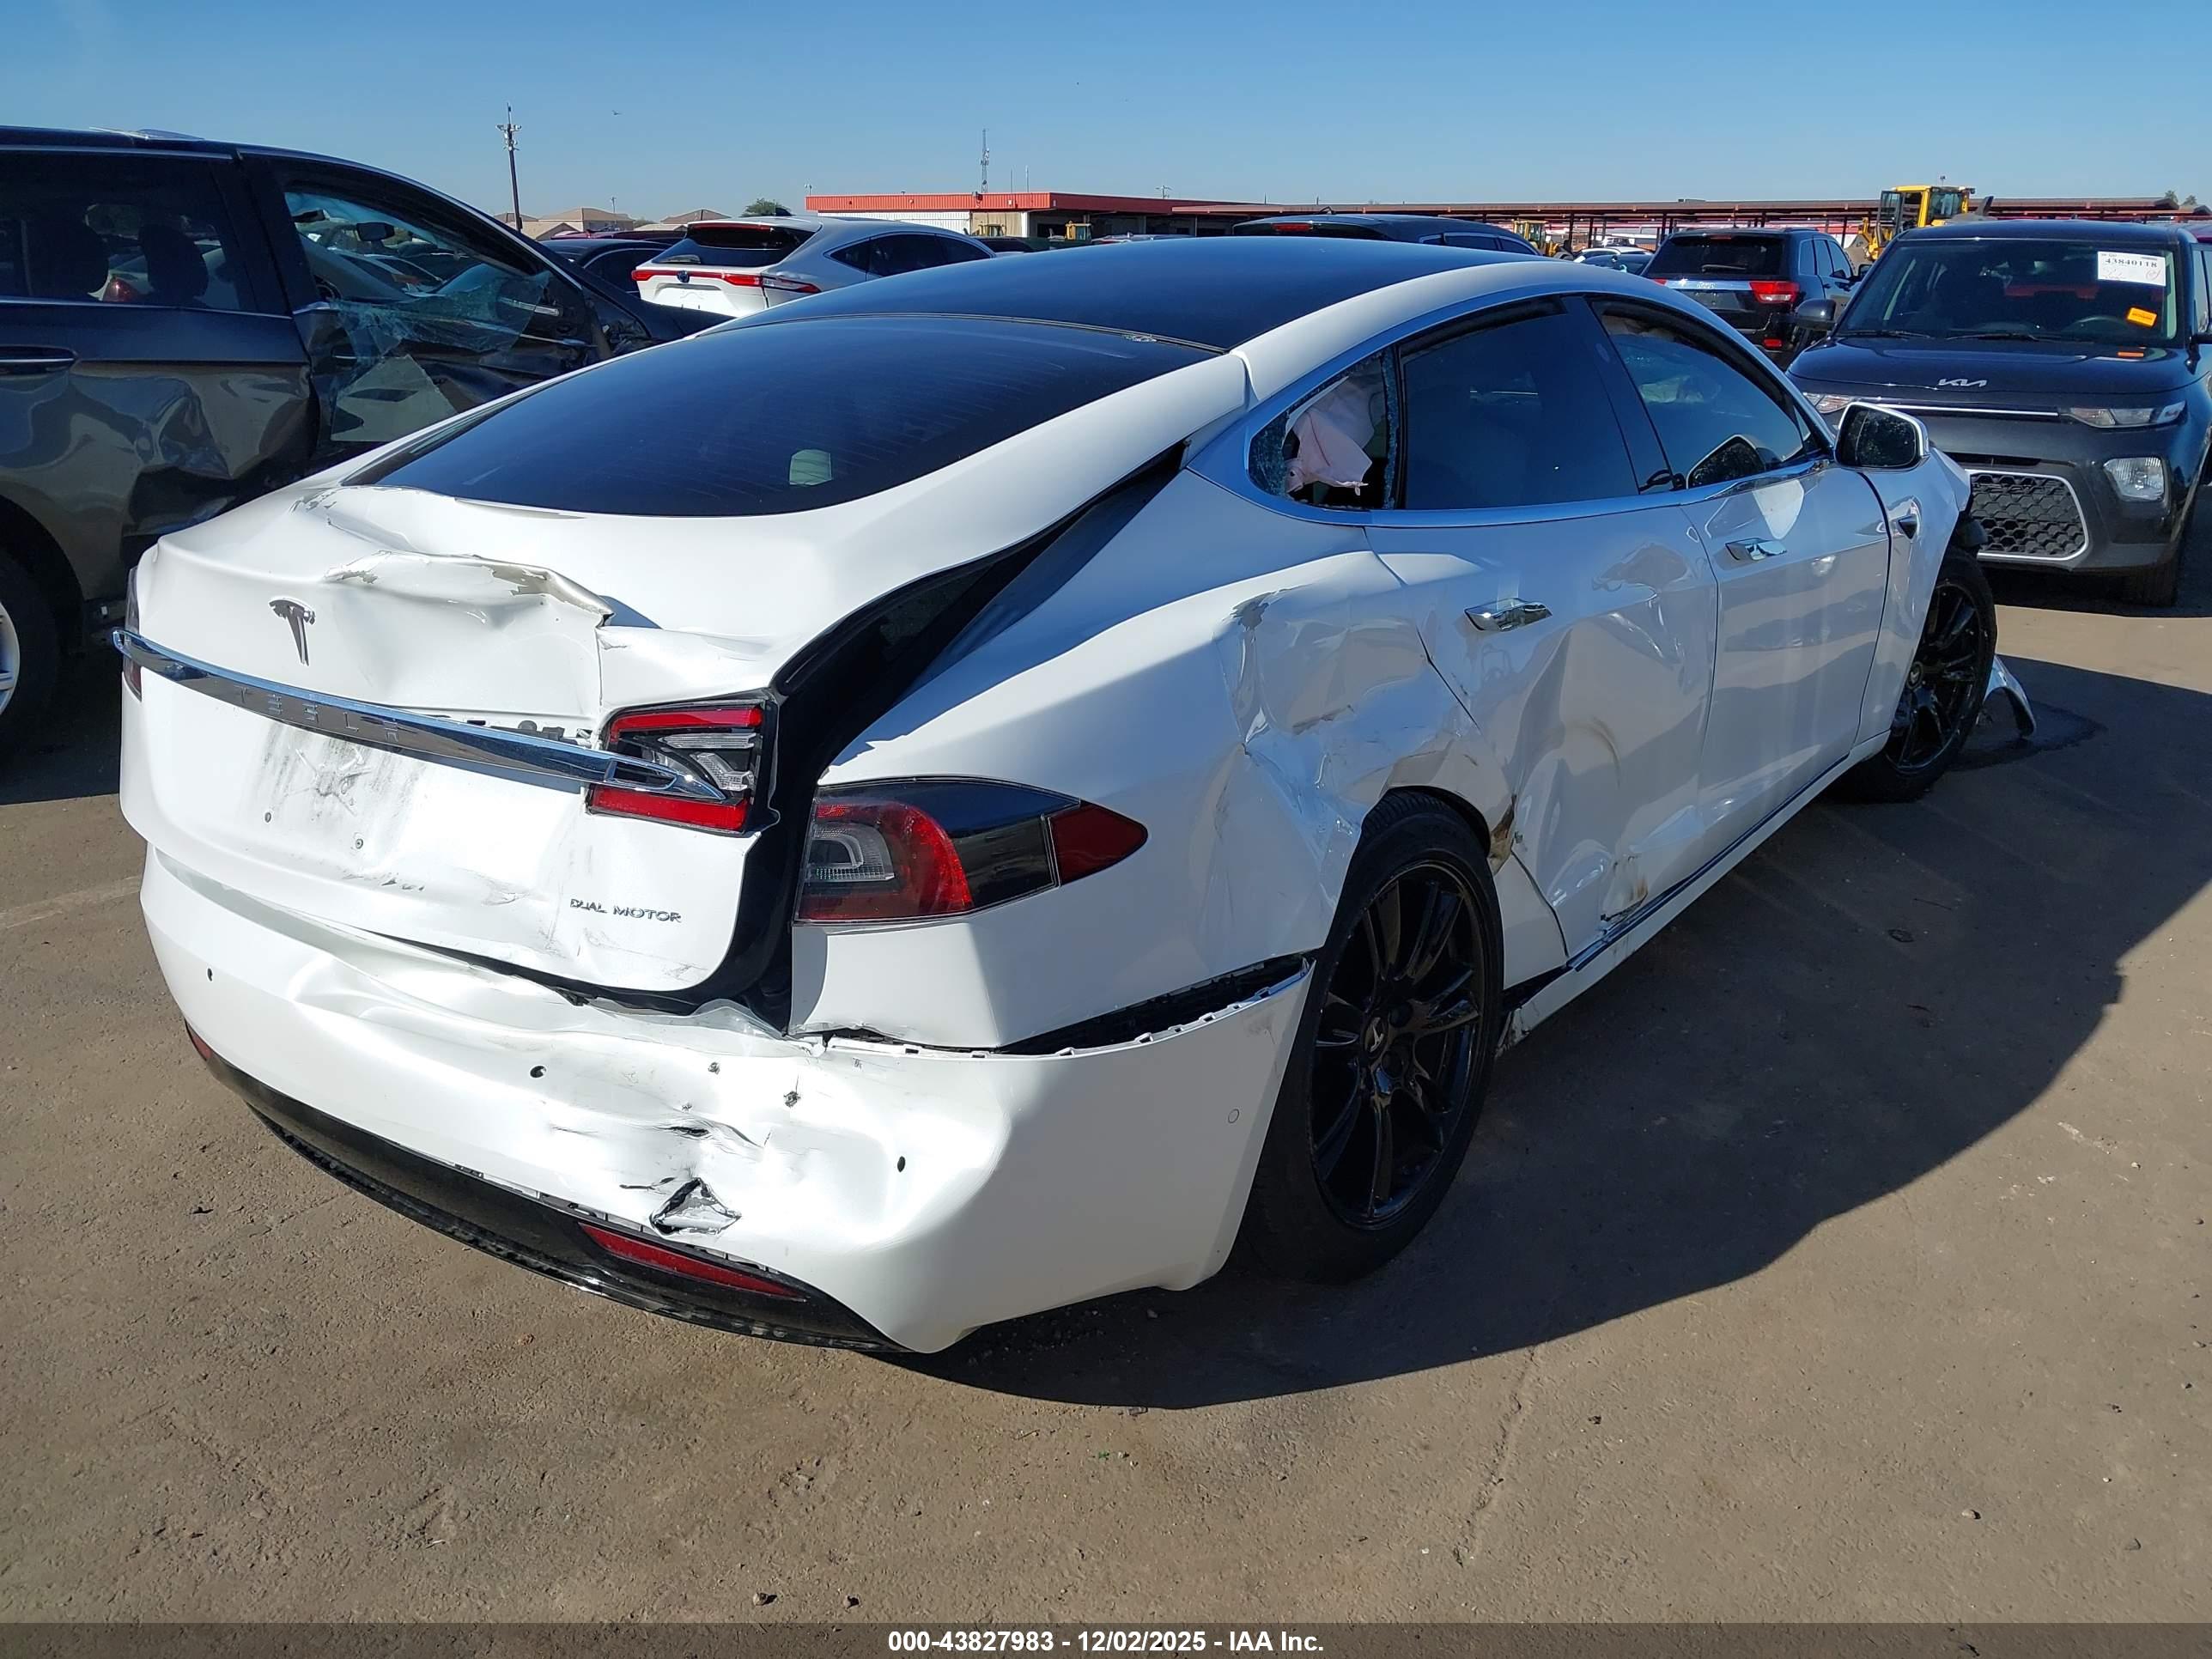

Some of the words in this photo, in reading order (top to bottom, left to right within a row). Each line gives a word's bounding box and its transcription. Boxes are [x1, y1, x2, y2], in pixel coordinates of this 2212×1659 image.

[234, 684, 399, 743] TESLA
[569, 898, 608, 914] DUAL
[613, 905, 682, 923] MOTOR
